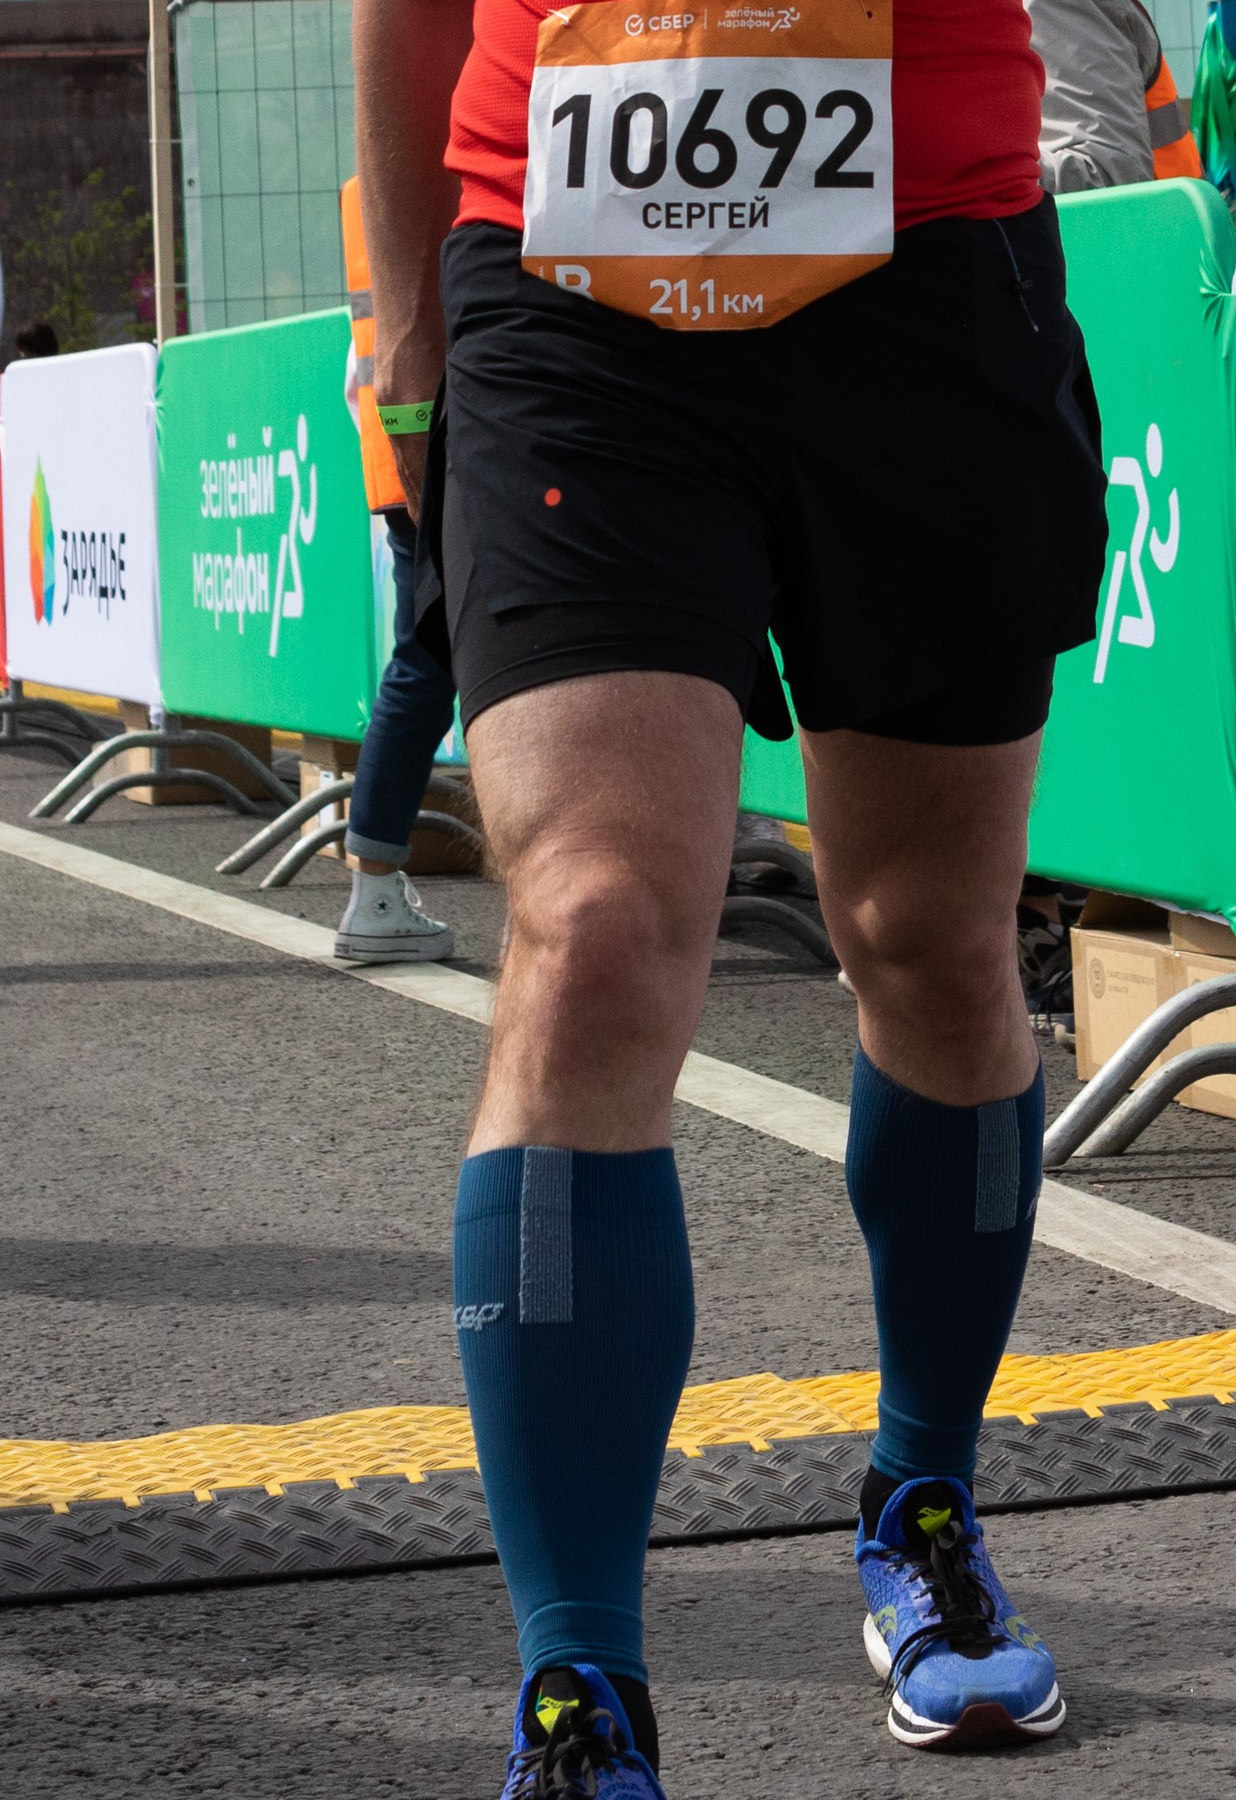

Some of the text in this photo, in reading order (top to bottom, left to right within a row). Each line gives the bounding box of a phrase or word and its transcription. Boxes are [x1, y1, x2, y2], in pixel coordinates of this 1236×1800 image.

[648, 13, 695, 31] СБЕР
[718, 17, 770, 30] марафон
[725, 6, 775, 18] зелёный
[552, 88, 875, 189] 10692
[642, 195, 770, 230] СЕРГЕЙ
[649, 278, 764, 321] 21,1 км
[200, 426, 275, 519] зелёный
[61, 528, 126, 621] ЗАРЯДЬЕ
[192, 526, 270, 636] марафон
